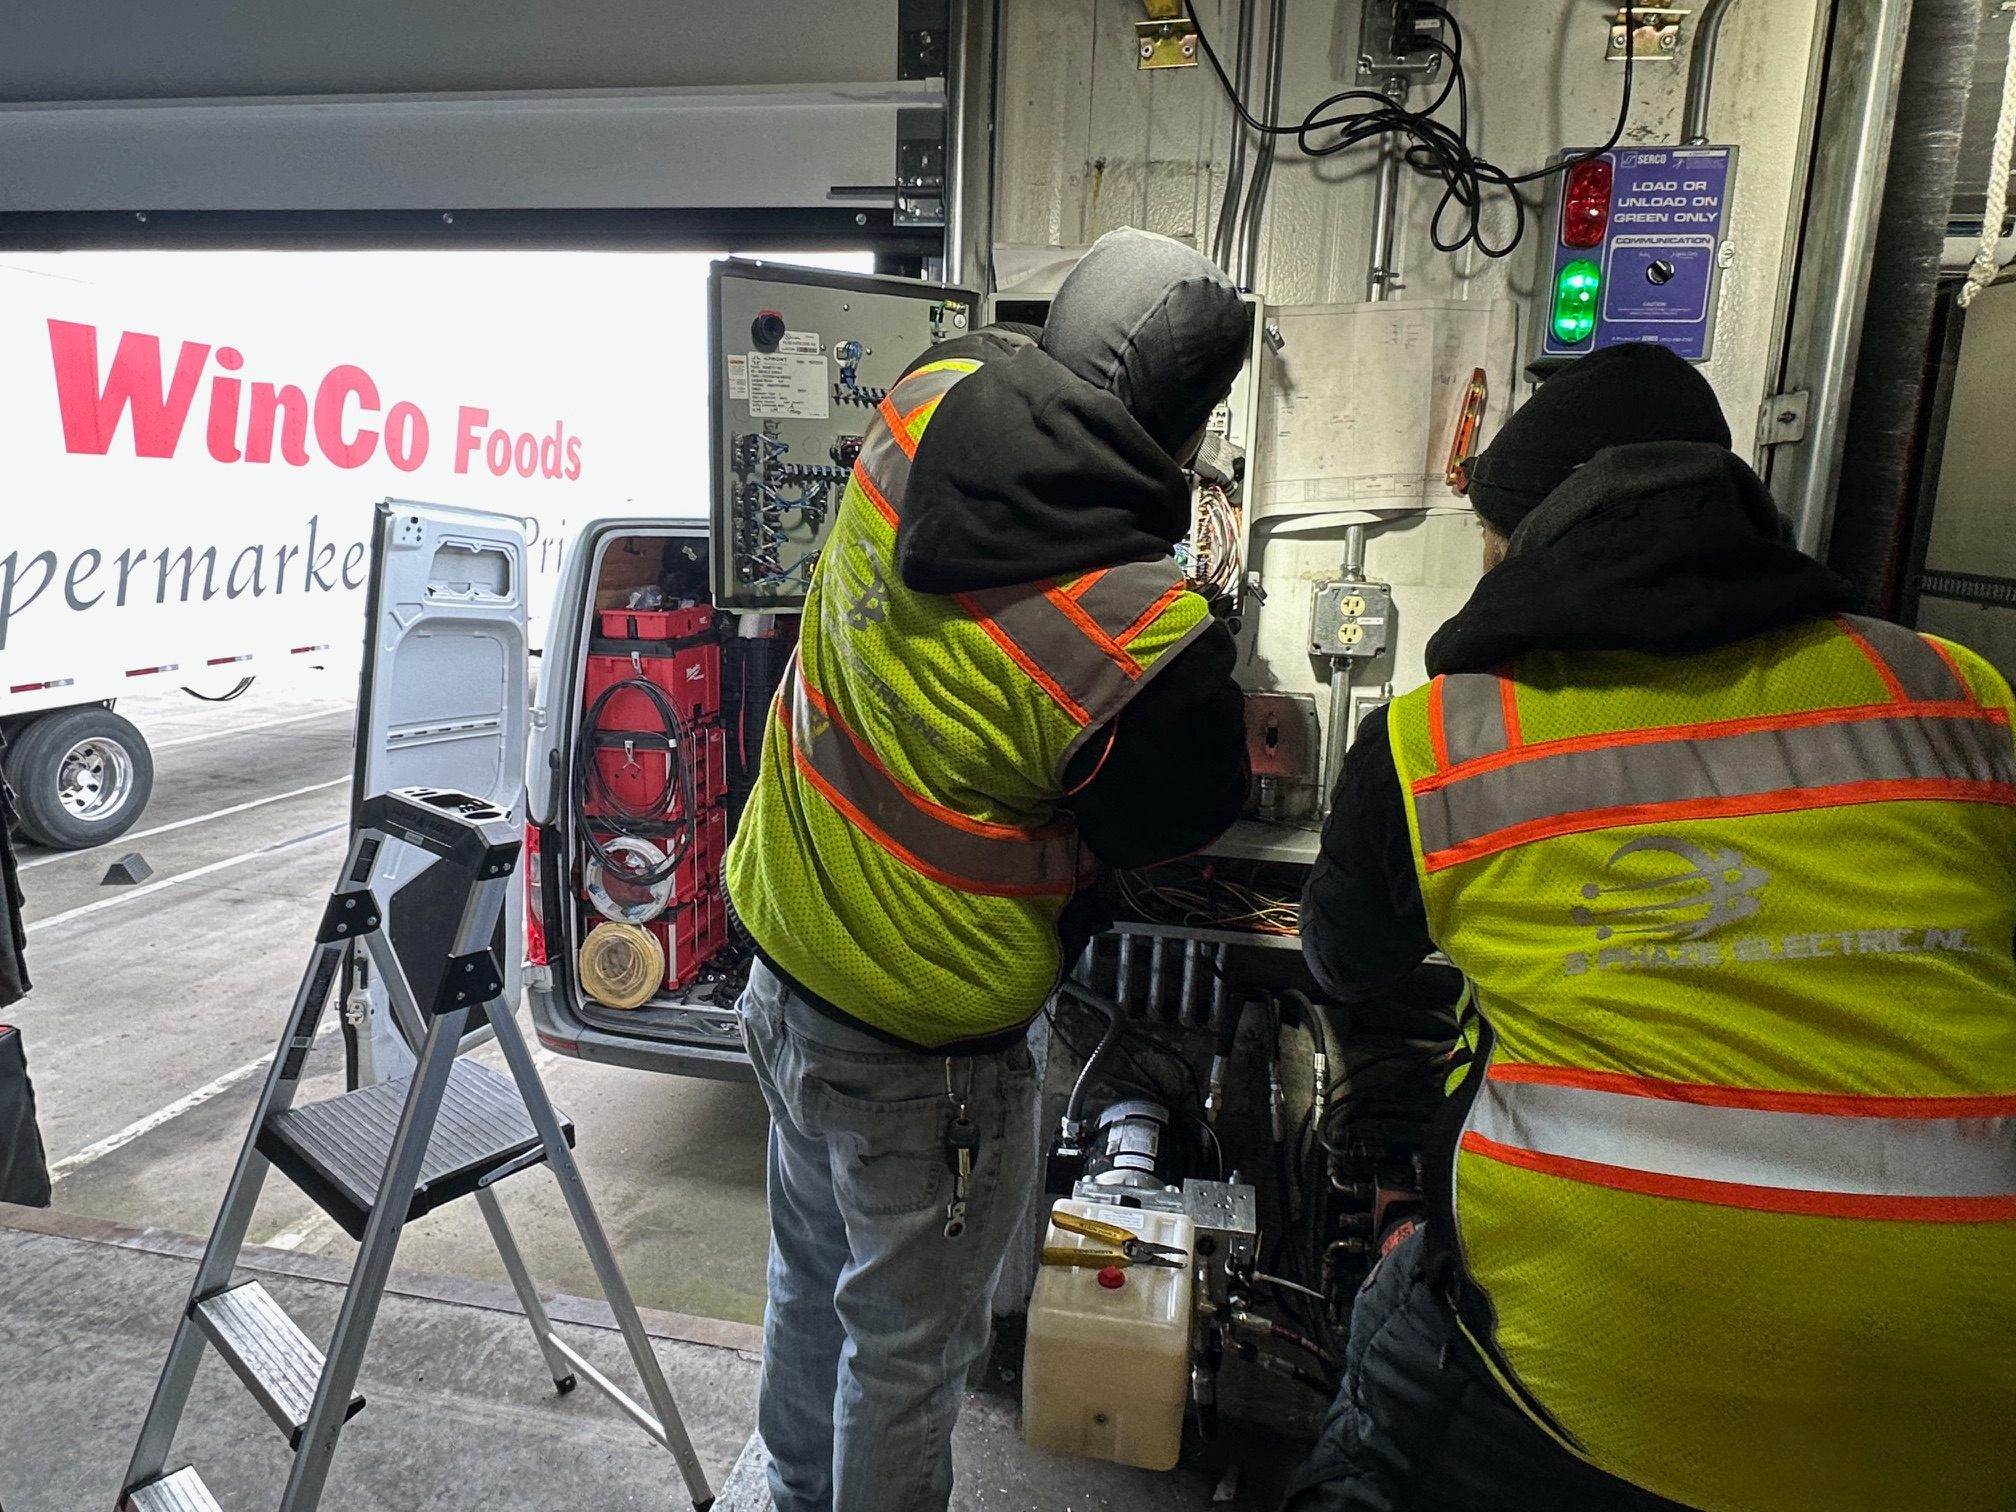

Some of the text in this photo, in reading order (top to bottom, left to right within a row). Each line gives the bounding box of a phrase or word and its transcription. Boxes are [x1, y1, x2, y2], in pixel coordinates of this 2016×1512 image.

[1637, 154, 1667, 165] SERCO
[1632, 181, 1708, 192] LOAD OR
[1618, 196, 1718, 207] UNLOAD ON
[1613, 212, 1719, 223] GREEN ONLY
[1615, 237, 1711, 245] COMMUNICATION
[47, 318, 583, 482] WinCo Foods
[1331, 588, 1341, 601] 7
[1563, 951, 1588, 976] 3
[1598, 941, 1724, 971] PHAZE
